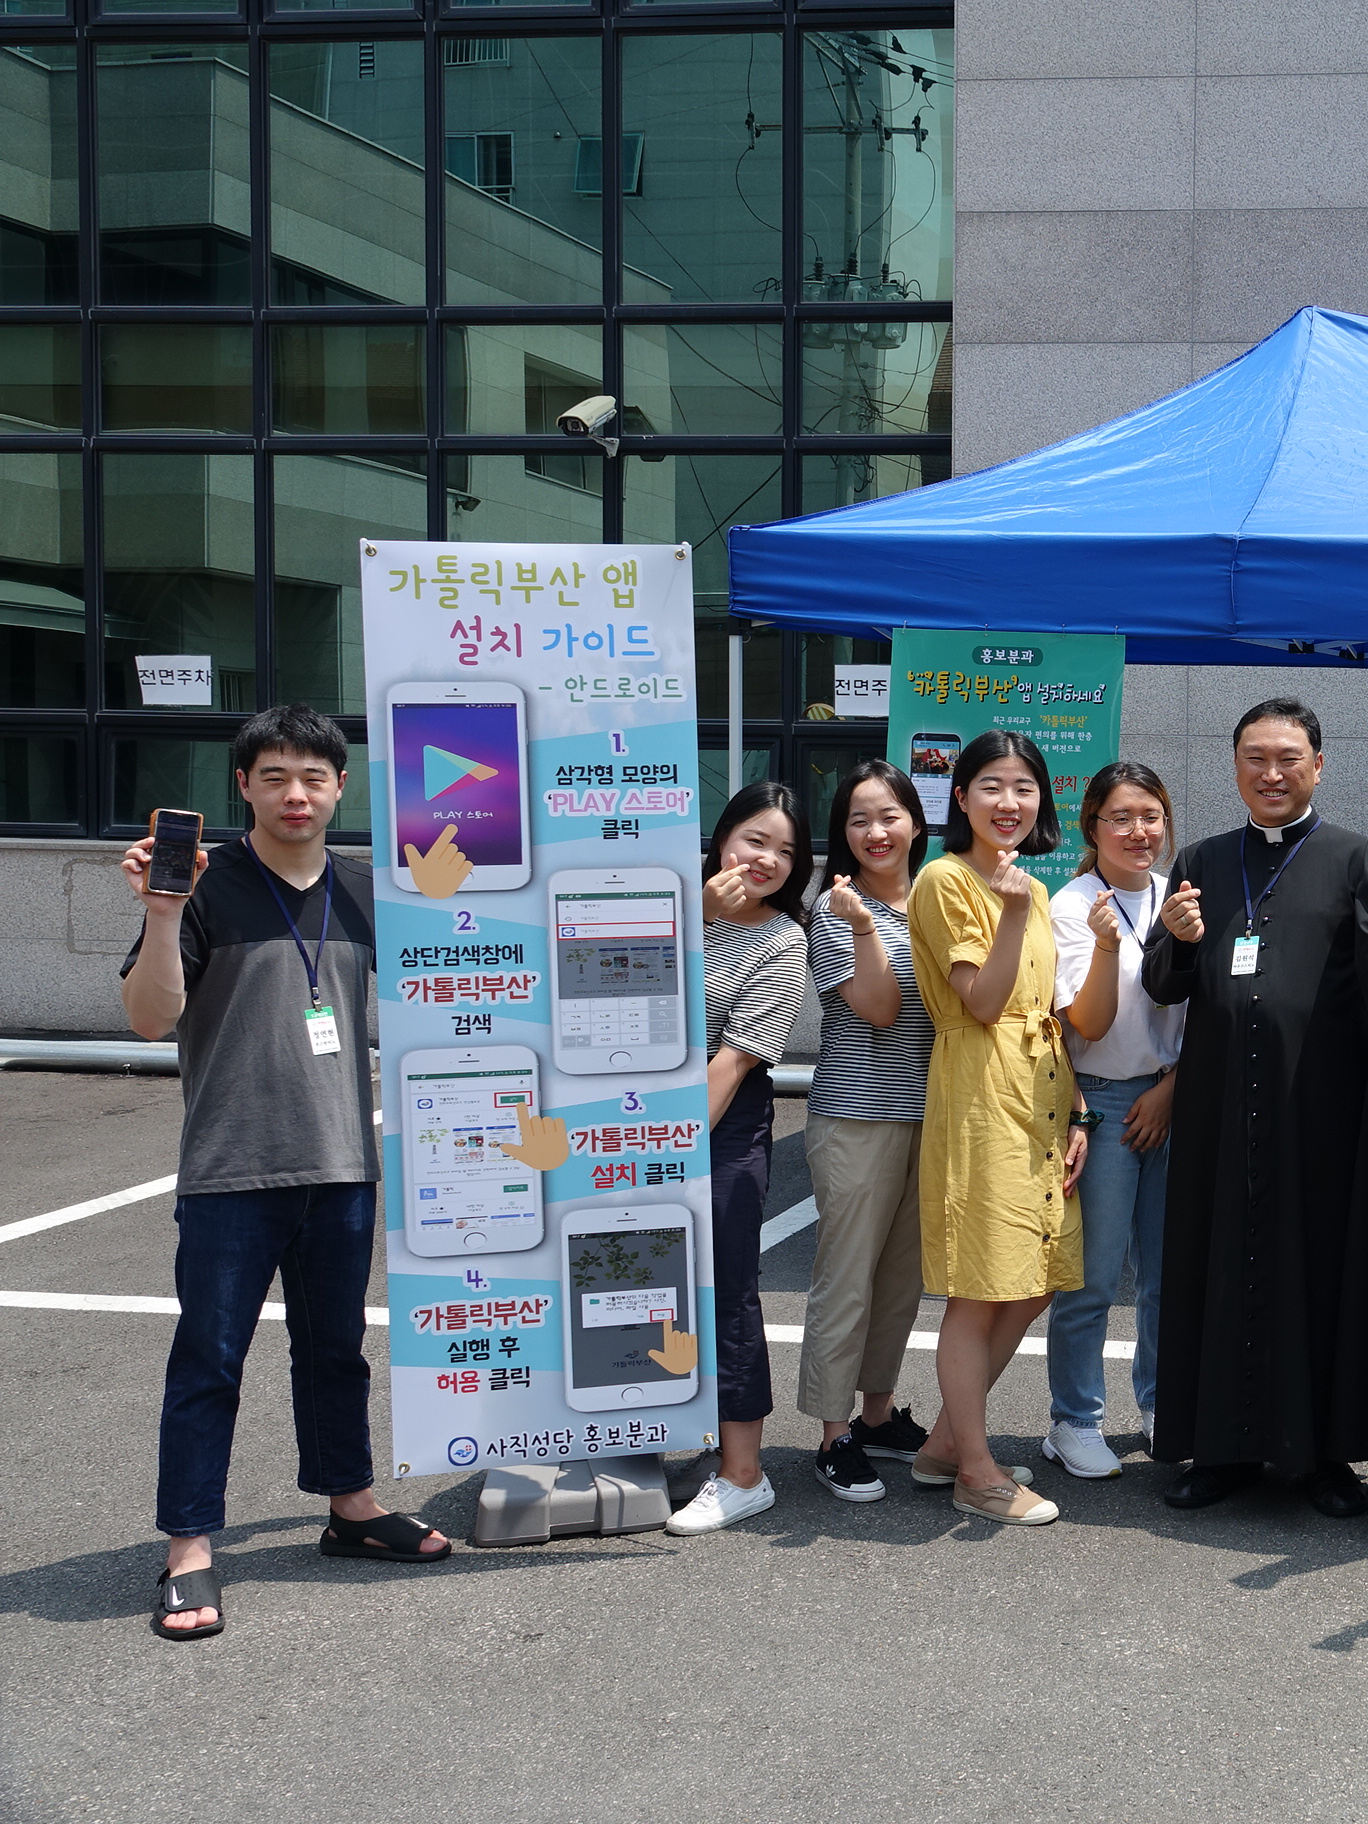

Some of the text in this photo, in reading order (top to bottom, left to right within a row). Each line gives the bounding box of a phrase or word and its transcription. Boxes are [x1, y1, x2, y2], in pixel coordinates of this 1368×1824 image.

[389, 555, 638, 609] 가톨릭부산 앱
[450, 615, 655, 666] 설치 가이드
[980, 649, 1034, 664] 홍보분과
[139, 669, 212, 686] 전면주차
[565, 675, 683, 702] 안드로이드
[1018, 682, 1032, 703] 앱
[1036, 682, 1106, 704] 설치하세요
[993, 715, 1006, 725] 최근
[1006, 716, 1031, 725] 우리교구
[612, 733, 626, 752] 1.
[1034, 731, 1057, 741] 편의를
[1060, 731, 1075, 740] 위해
[1077, 732, 1093, 741] 한층
[1052, 744, 1082, 754] 버전으로
[555, 764, 678, 785] 삼각형 모양의
[1052, 775, 1078, 794] 설치
[433, 810, 493, 819] PLAY 스토어
[601, 819, 639, 840] 클릭
[1049, 852, 1076, 862] 이용하고
[1033, 865, 1053, 875] 삭제한
[457, 910, 476, 931] 2.
[399, 944, 524, 968] 상단검색창에
[451, 1014, 492, 1036] 검색
[624, 1091, 643, 1111] 3.
[590, 1162, 685, 1189] 설치 클릭
[466, 1269, 488, 1288] 4.
[447, 1336, 520, 1363] 실행 후
[436, 1366, 530, 1394] 허용 클릭
[487, 1421, 668, 1458] 사직성당 홍보분과
